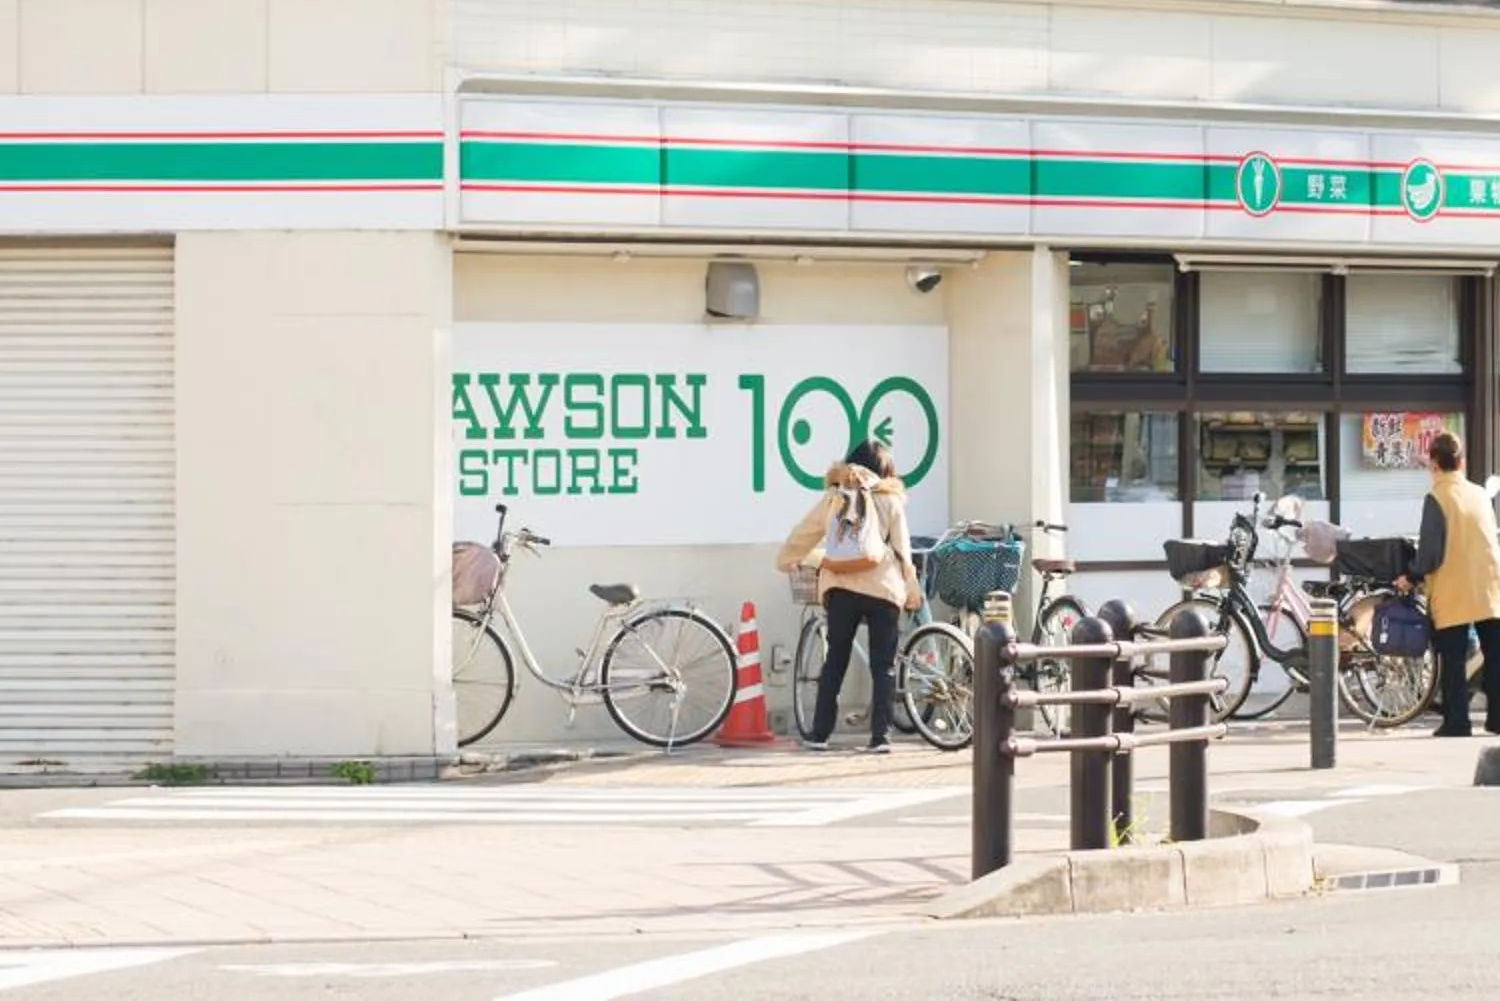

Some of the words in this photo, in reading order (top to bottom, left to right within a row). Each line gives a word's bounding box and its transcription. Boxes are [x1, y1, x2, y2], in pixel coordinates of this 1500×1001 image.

[1307, 174, 1346, 199] 野菜
[452, 373, 707, 439] AWSON
[738, 374, 939, 493] 100
[459, 448, 637, 495] STORE
